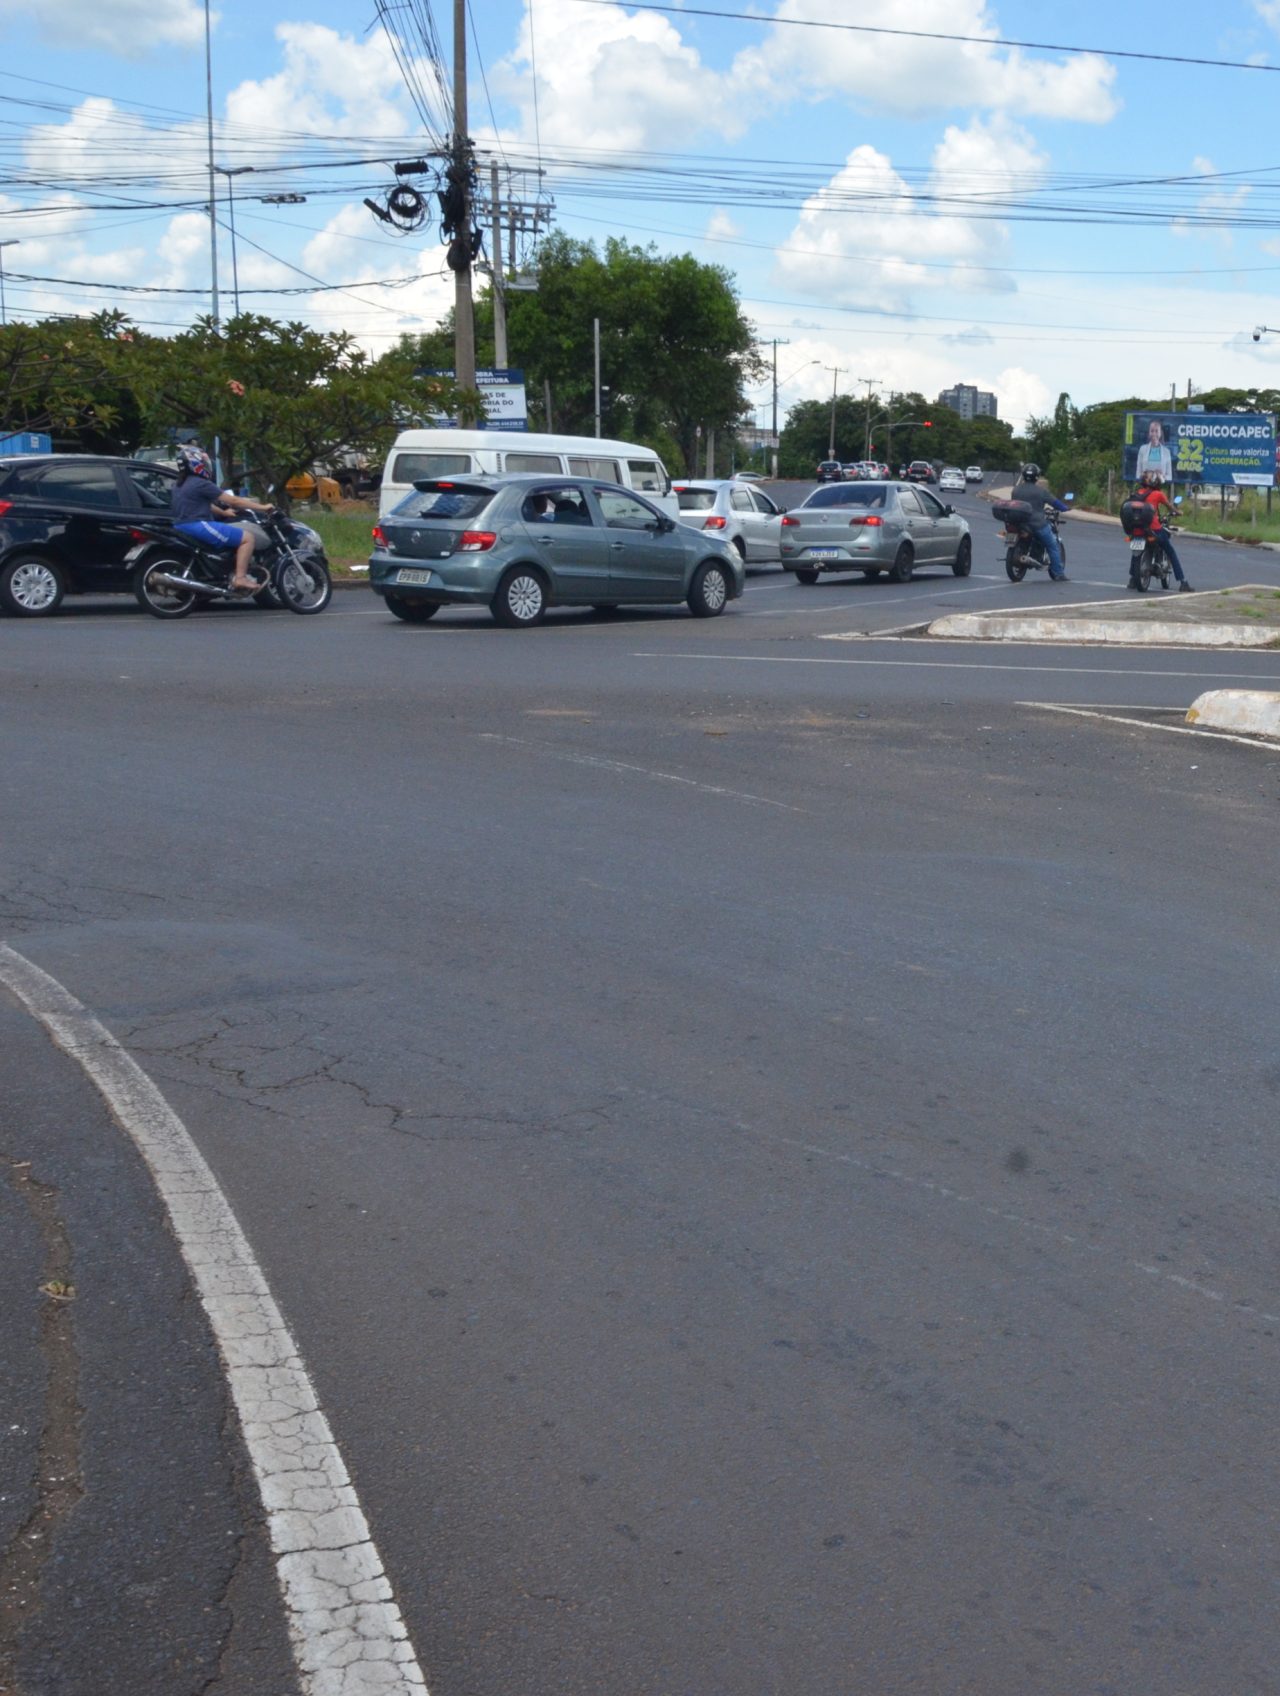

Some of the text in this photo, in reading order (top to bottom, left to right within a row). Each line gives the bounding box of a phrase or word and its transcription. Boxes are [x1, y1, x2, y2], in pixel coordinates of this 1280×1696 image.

[1177, 424, 1271, 438] CREDICOCAPEC
[1177, 438, 1204, 460] 32
[1229, 448, 1243, 457] que
[1243, 447, 1270, 457] valoriza
